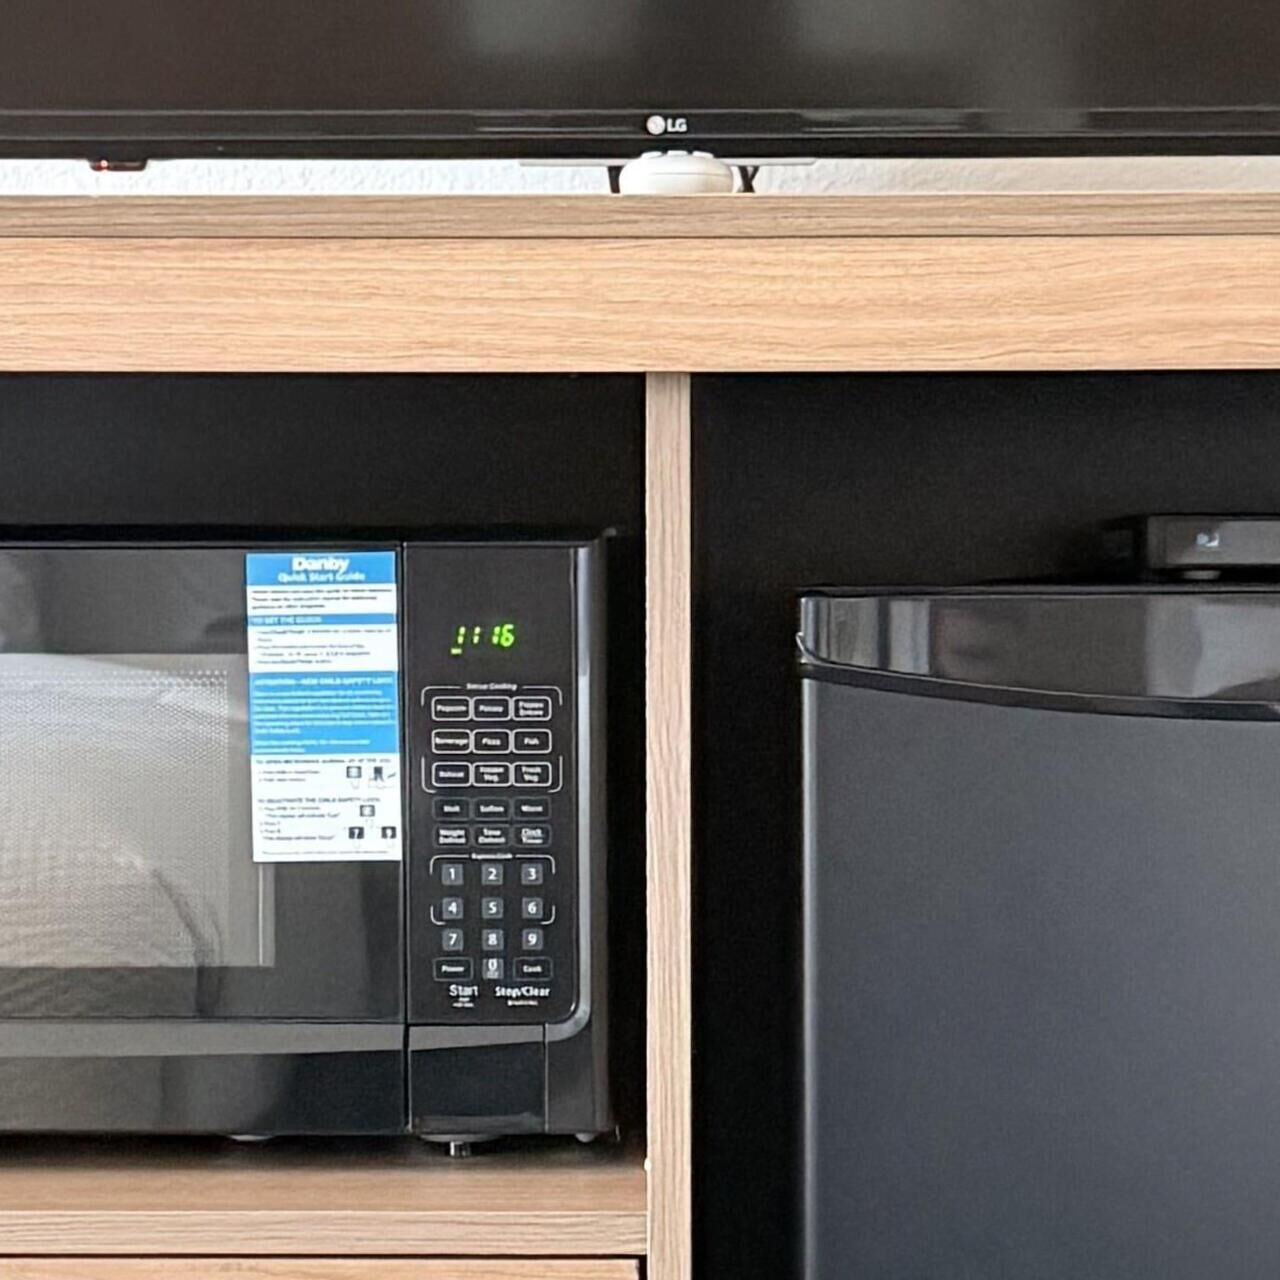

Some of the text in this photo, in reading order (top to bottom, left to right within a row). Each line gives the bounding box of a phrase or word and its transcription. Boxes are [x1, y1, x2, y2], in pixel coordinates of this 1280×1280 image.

[667, 118, 687, 132] LG
[292, 556, 350, 574] Danby
[278, 571, 365, 583] Quick Start Guide
[449, 868, 455, 880] 1
[488, 867, 498, 880] 2
[527, 867, 537, 880] 3
[448, 901, 457, 914] 4
[488, 901, 497, 914] 5
[527, 901, 537, 914] 6
[448, 933, 457, 945] 7
[488, 933, 498, 945] 8
[527, 933, 537, 945] 9
[488, 958, 497, 970] 0
[449, 984, 479, 996] Start
